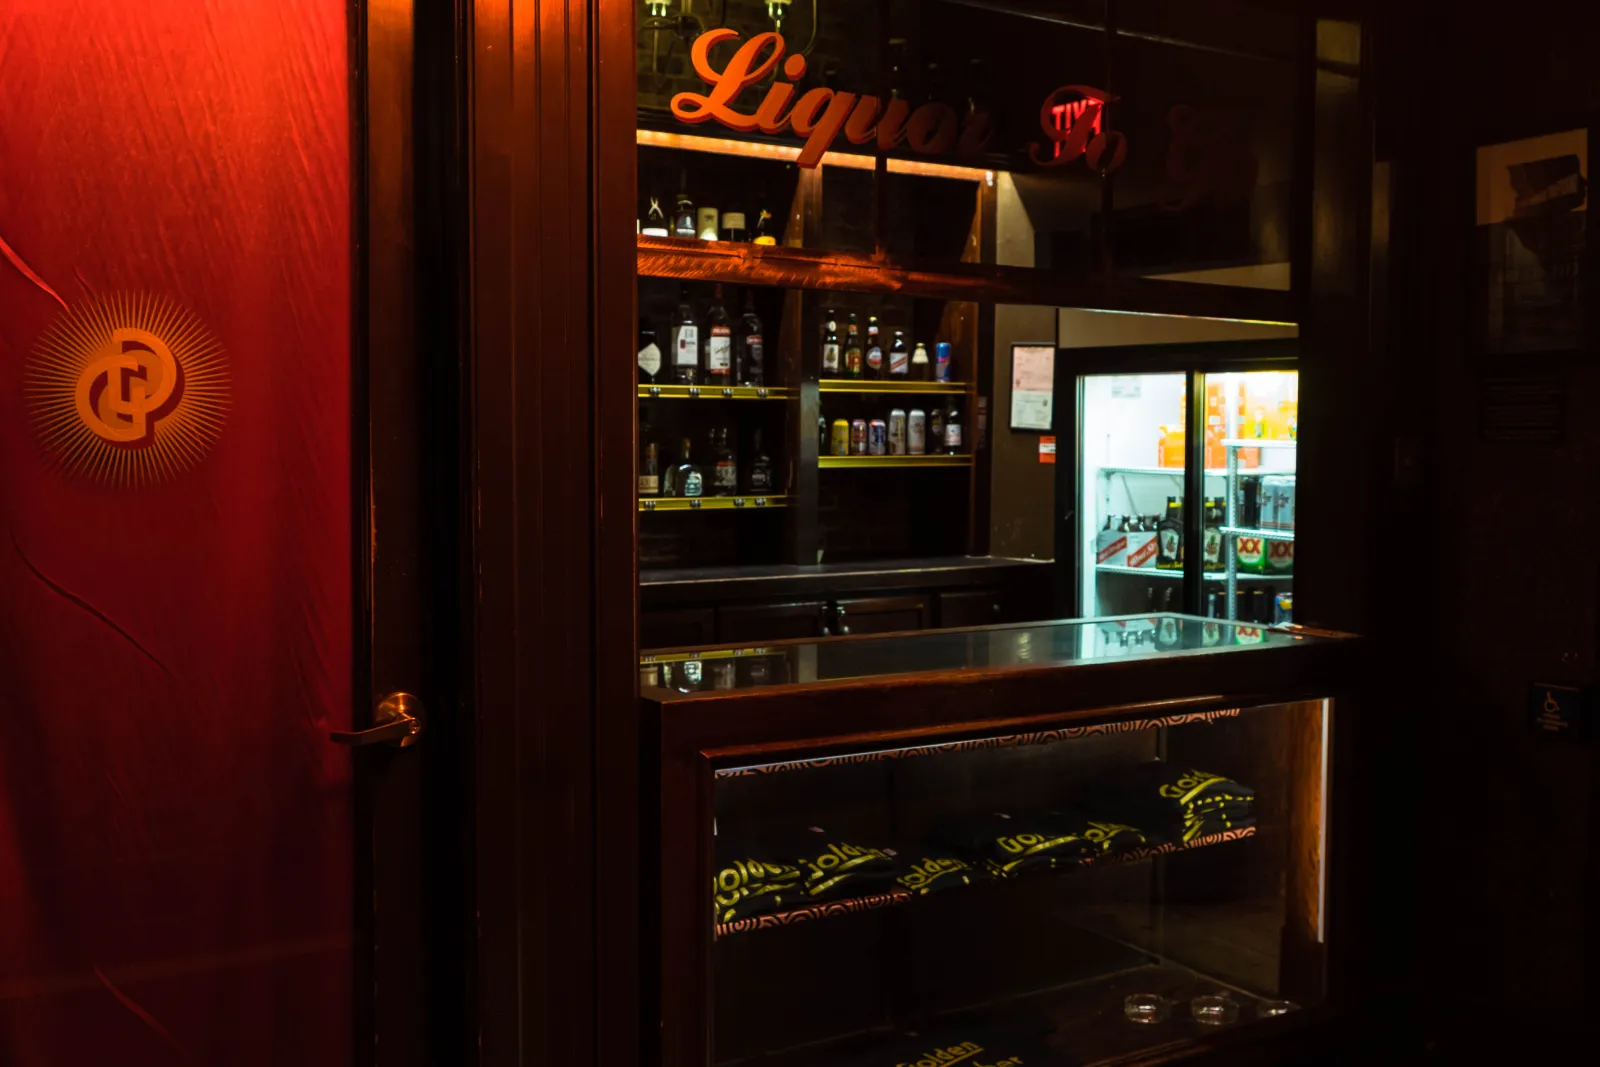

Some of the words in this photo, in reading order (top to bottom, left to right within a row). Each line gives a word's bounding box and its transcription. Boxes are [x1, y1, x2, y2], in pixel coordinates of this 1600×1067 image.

[670, 27, 997, 168] Liquor
[1028, 84, 1128, 173] To
[1238, 537, 1261, 555] XX
[895, 1041, 982, 1067] olden
